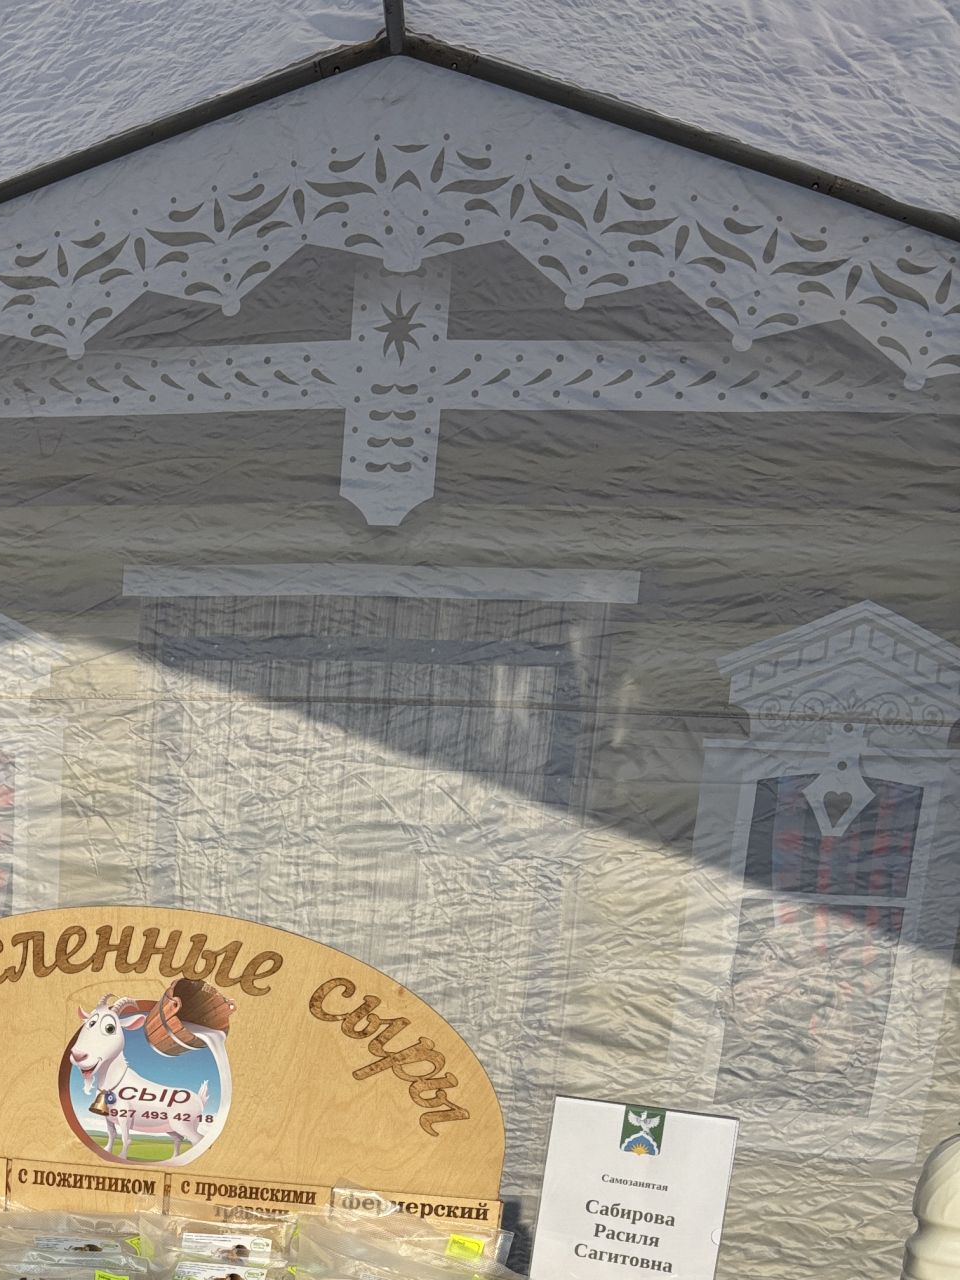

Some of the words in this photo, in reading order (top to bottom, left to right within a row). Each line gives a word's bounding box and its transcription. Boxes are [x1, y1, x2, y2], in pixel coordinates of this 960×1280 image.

[308, 977, 470, 1137] сыры
[110, 1108, 136, 1118] 927
[141, 1110, 168, 1120] 493
[173, 1112, 191, 1122] 42
[196, 1114, 214, 1123] 18
[32, 1169, 156, 1196] пожитником
[195, 1180, 317, 1206] прованскими
[601, 1173, 668, 1192] Самозанятая
[585, 1199, 675, 1227] Сабирова
[593, 1223, 660, 1248] Расиля
[574, 1243, 673, 1273] Сагитовна
